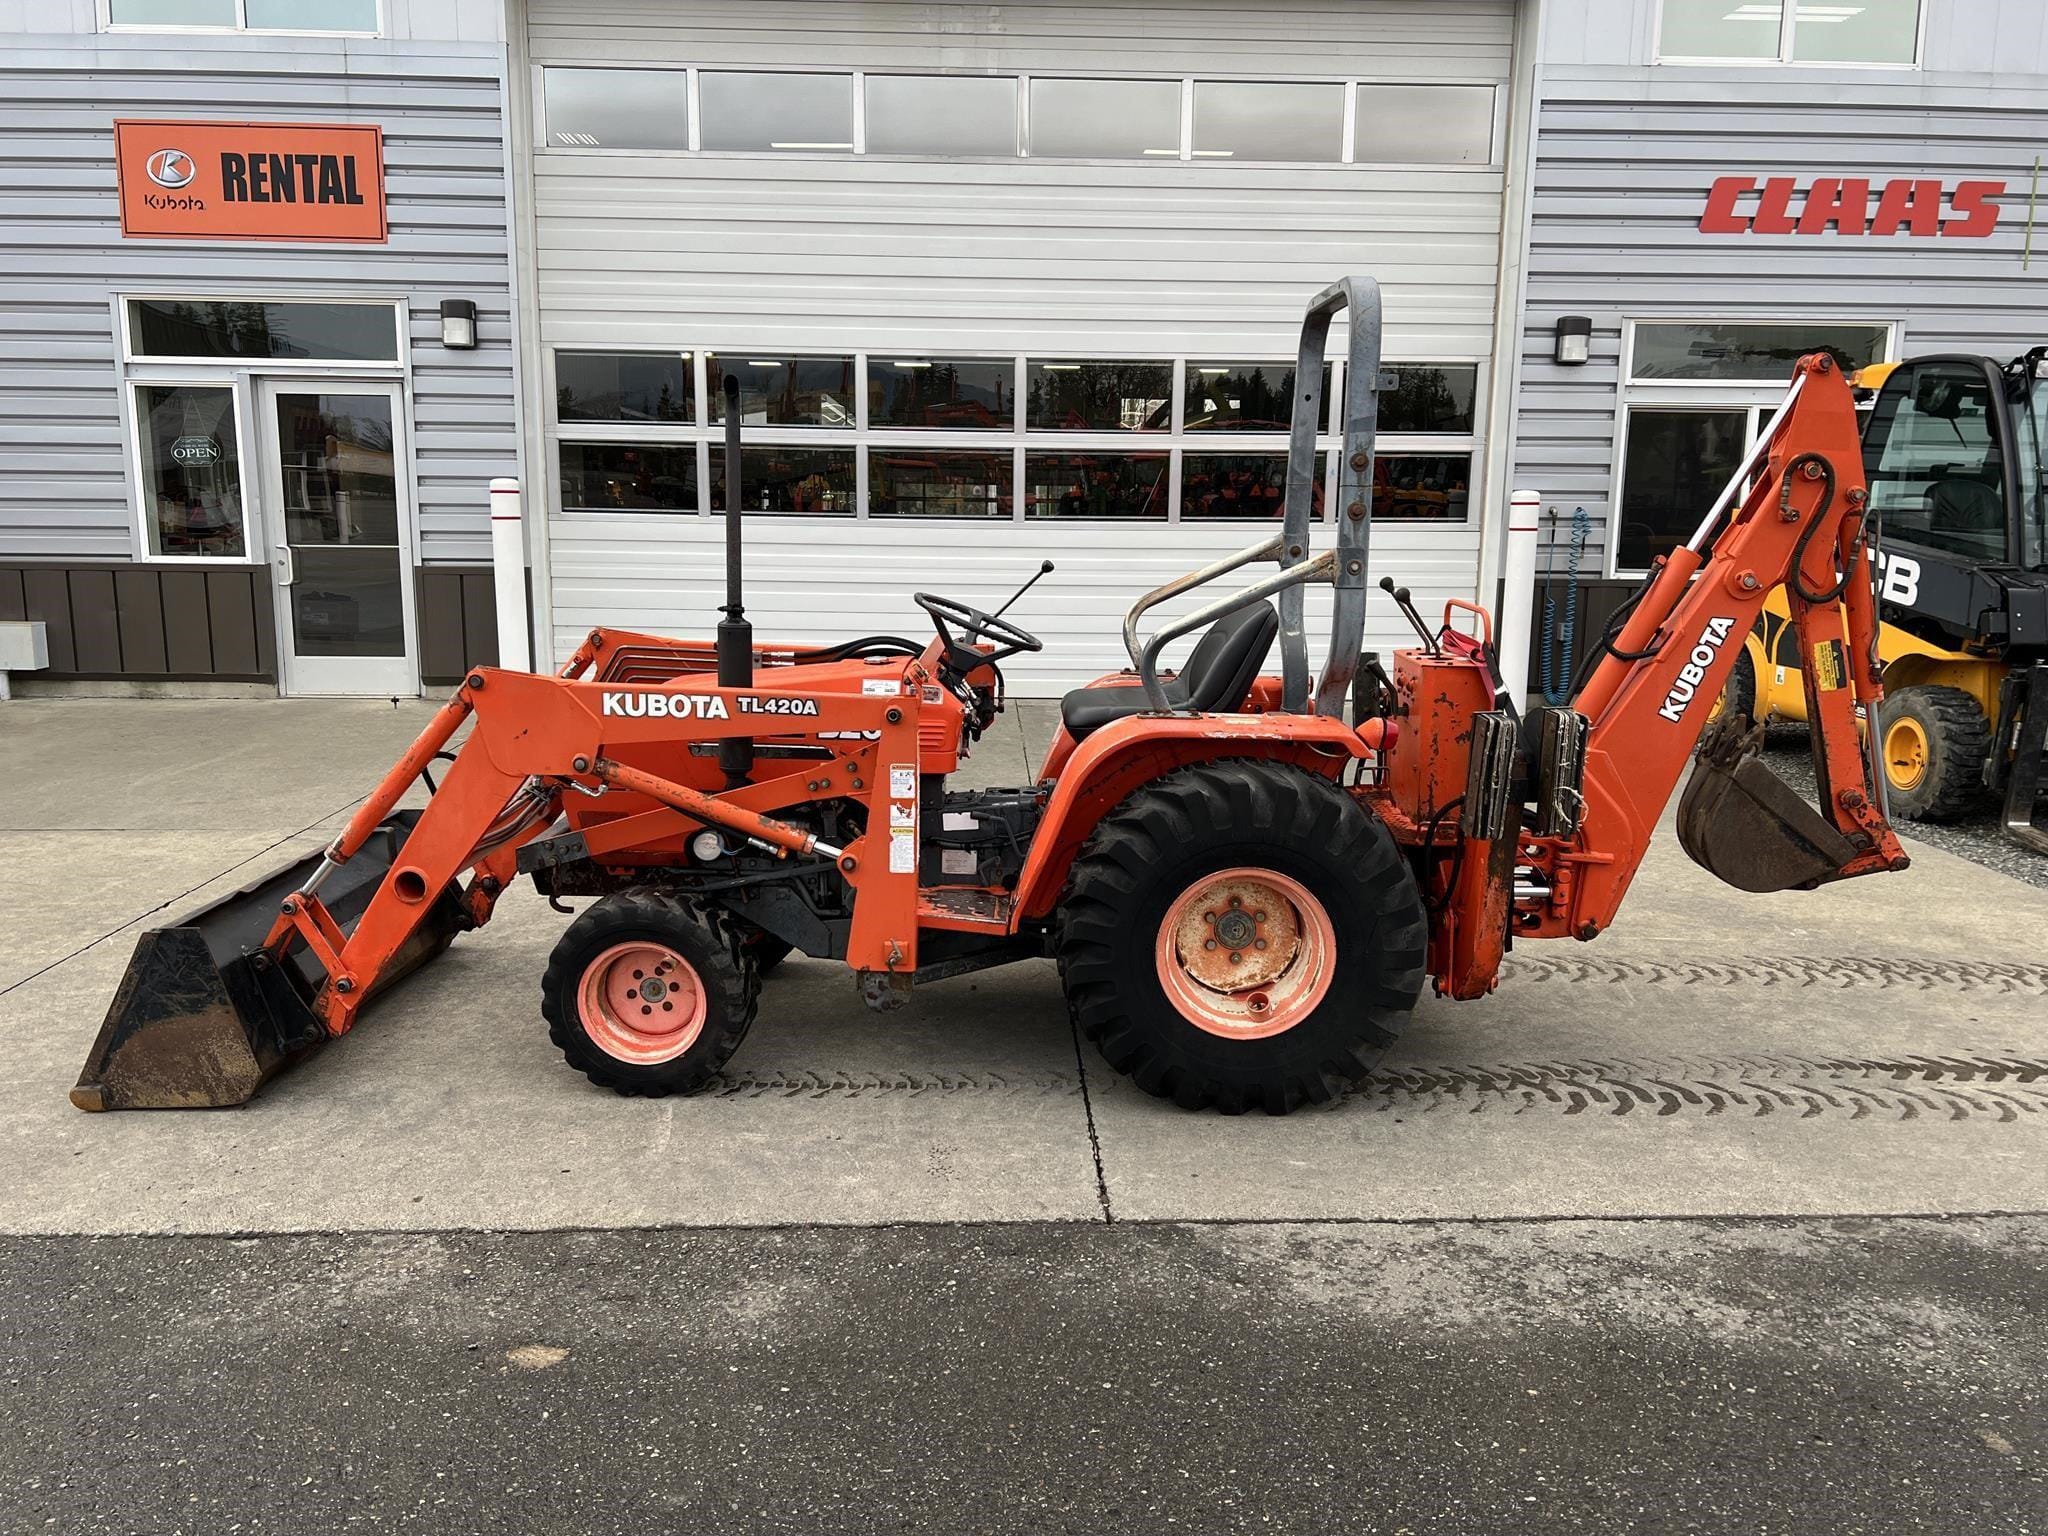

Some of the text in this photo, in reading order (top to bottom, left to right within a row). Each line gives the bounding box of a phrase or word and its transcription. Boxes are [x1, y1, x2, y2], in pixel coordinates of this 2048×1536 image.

[220, 152, 364, 205] RENTAL
[144, 193, 206, 211] Kubota
[1698, 176, 2007, 238] CLAAS
[173, 447, 218, 459] OPEN
[1657, 616, 1737, 724] KUBOTA
[602, 692, 818, 720] KUBOTA TL420A
